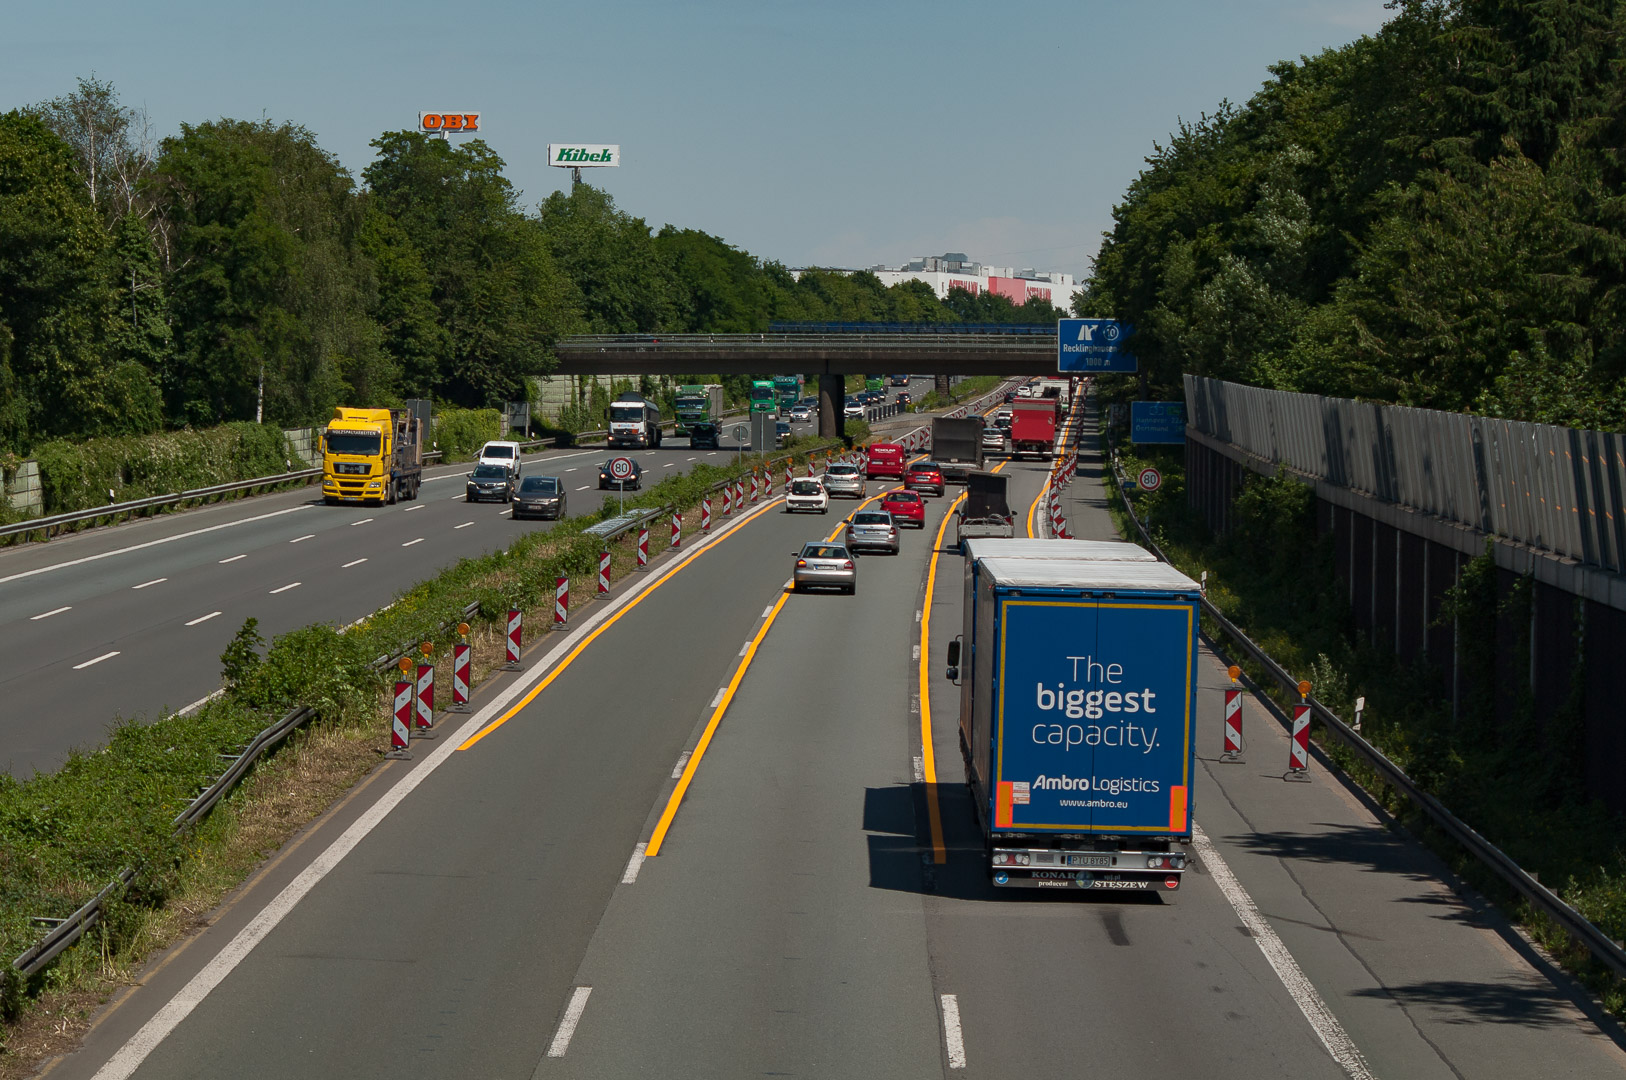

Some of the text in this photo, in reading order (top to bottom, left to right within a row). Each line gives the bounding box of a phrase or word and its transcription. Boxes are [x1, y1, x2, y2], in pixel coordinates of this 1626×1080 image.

[423, 114, 478, 129] OBI
[556, 148, 613, 162] Kibek
[615, 463, 628, 473] 80
[1143, 474, 1157, 485] 80
[1066, 655, 1123, 684] The
[1036, 682, 1157, 719] biggest
[1032, 719, 1160, 754] capacity.
[1032, 775, 1160, 795] Ambro Logistics
[1060, 799, 1128, 809] www.ambro.eu
